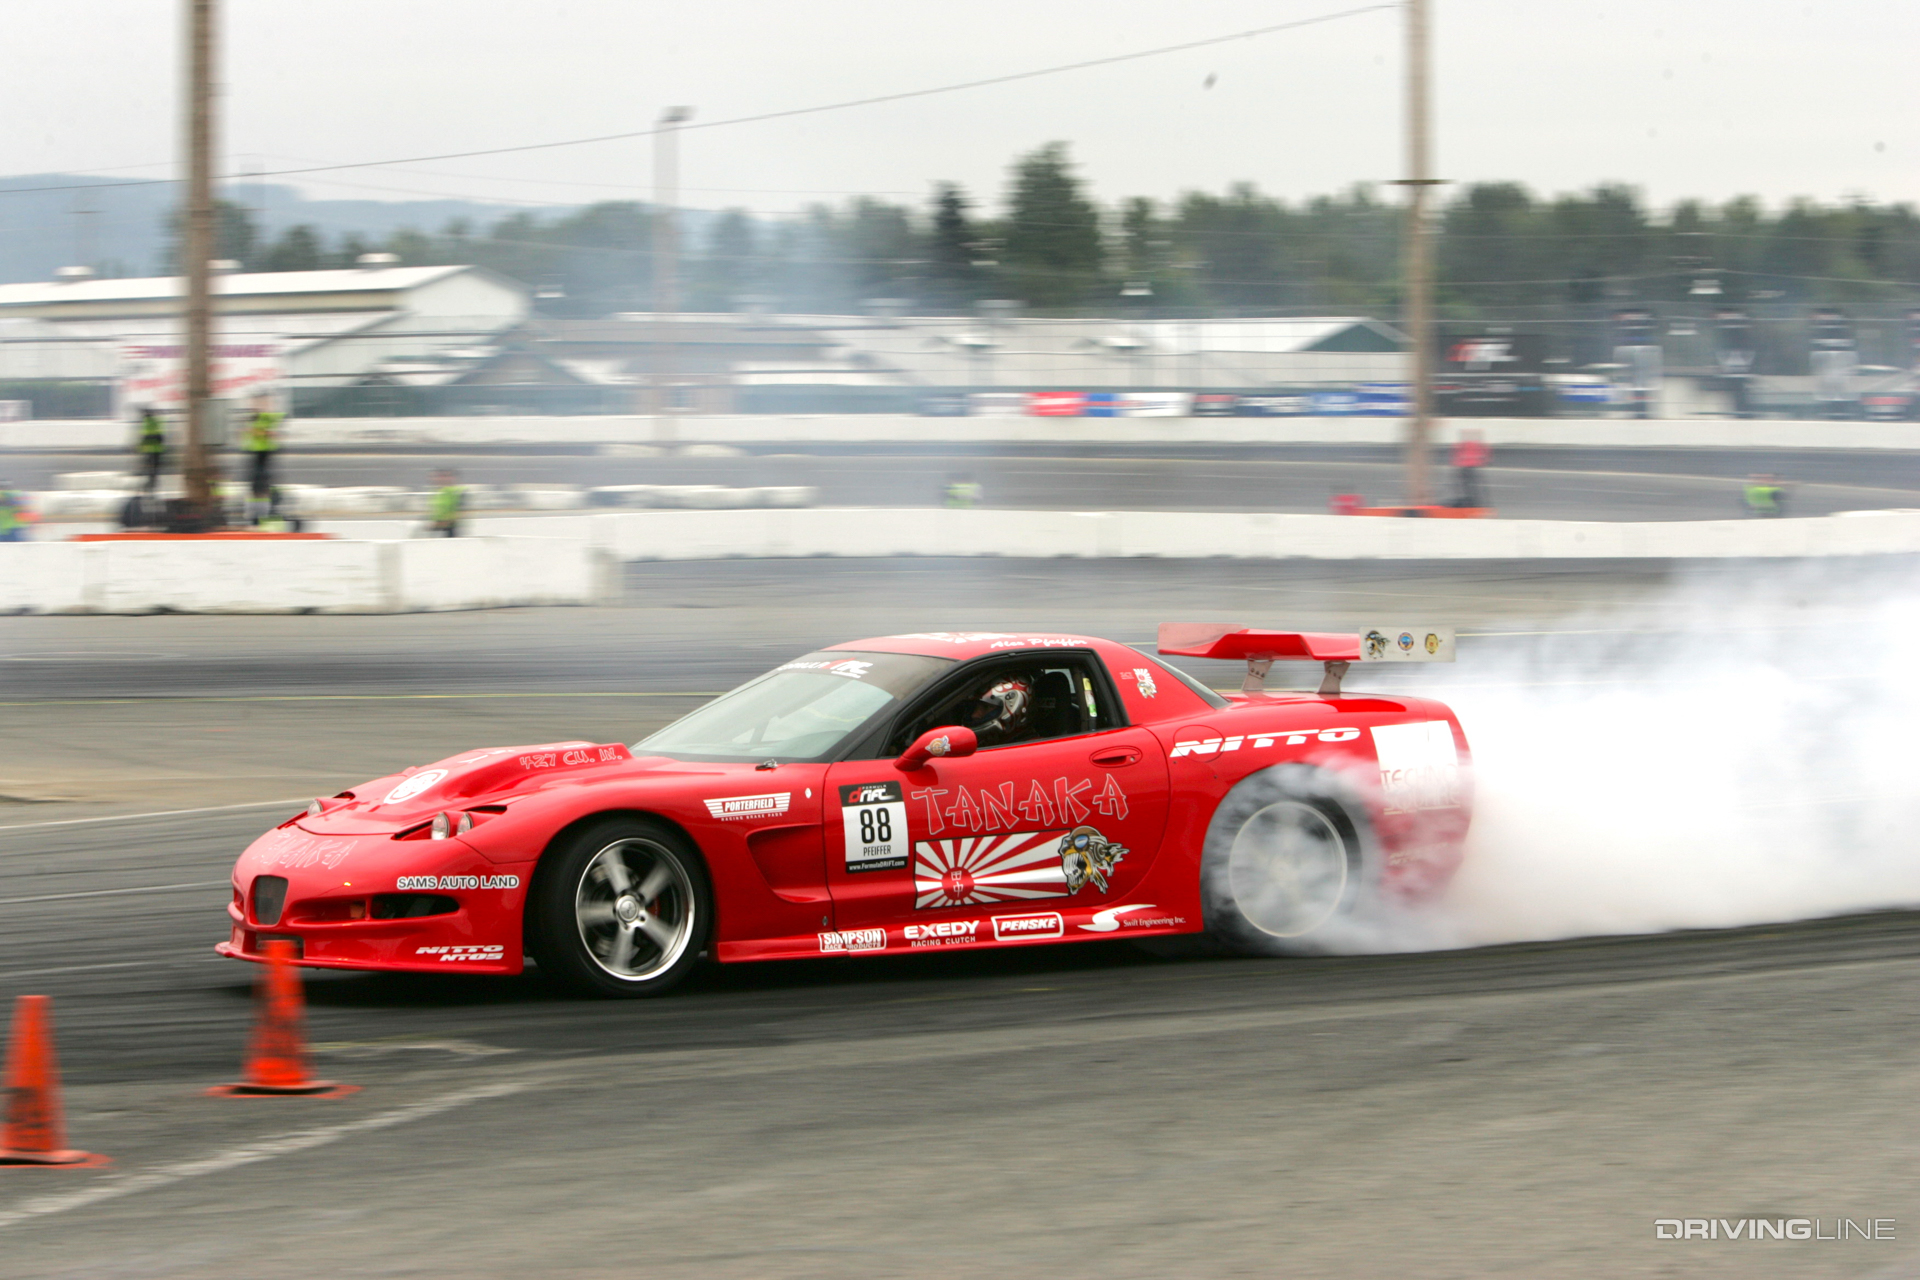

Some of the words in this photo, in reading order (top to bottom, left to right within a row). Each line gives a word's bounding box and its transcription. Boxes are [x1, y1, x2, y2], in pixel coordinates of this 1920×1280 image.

[1169, 727, 1361, 757] NITTO
[519, 753, 556, 769] 427
[562, 750, 595, 765] CU.
[599, 747, 623, 761] IN.
[725, 798, 774, 812] PORTERFIELD
[911, 774, 1129, 835] TANAKA
[860, 808, 892, 844] 88
[863, 845, 891, 857] PFEIFFER
[849, 860, 905, 871] www.FormulaDRIFT.com
[397, 876, 438, 890] SAMS
[438, 876, 480, 890] AUTO
[480, 875, 519, 889] LAND
[1000, 918, 1057, 931] PENSKE
[1123, 918, 1138, 927] Swift
[1139, 917, 1175, 928] Engineering
[1174, 916, 1187, 924] Inc.
[904, 920, 979, 939] EXEDY
[823, 931, 882, 944] SIMPSON
[911, 938, 941, 947] RACING
[945, 936, 976, 945] CLUTCH
[415, 945, 504, 954] NITTO
